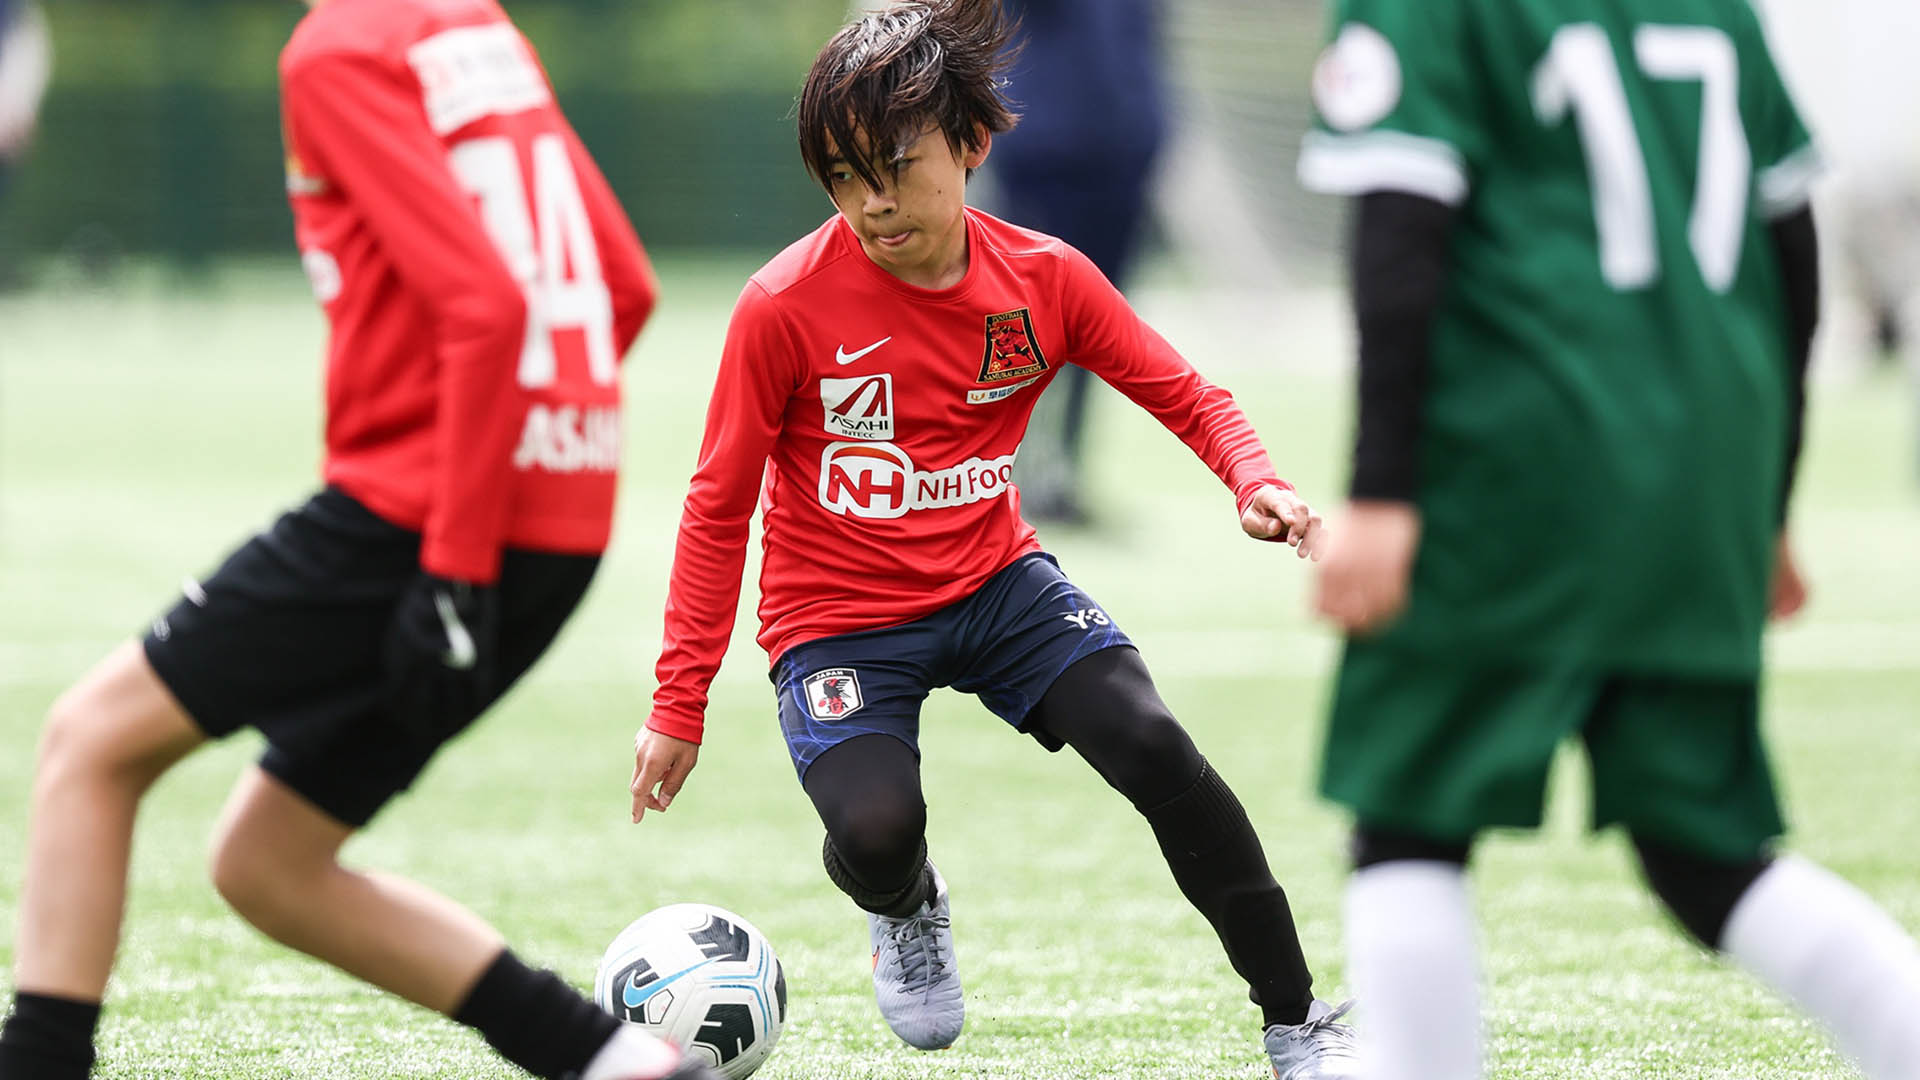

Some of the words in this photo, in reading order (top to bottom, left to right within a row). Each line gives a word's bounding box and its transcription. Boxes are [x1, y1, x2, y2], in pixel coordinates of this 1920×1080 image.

[1528, 21, 1751, 293] 17
[449, 134, 618, 388] 14
[983, 370, 1013, 381] SAMURAI
[1013, 364, 1042, 376] ACADEMY
[831, 415, 888, 431] ASAHI
[842, 429, 875, 438] INTECC
[917, 474, 961, 502] NH
[1064, 608, 1109, 629] Y-3
[815, 670, 844, 680] JAPAN
